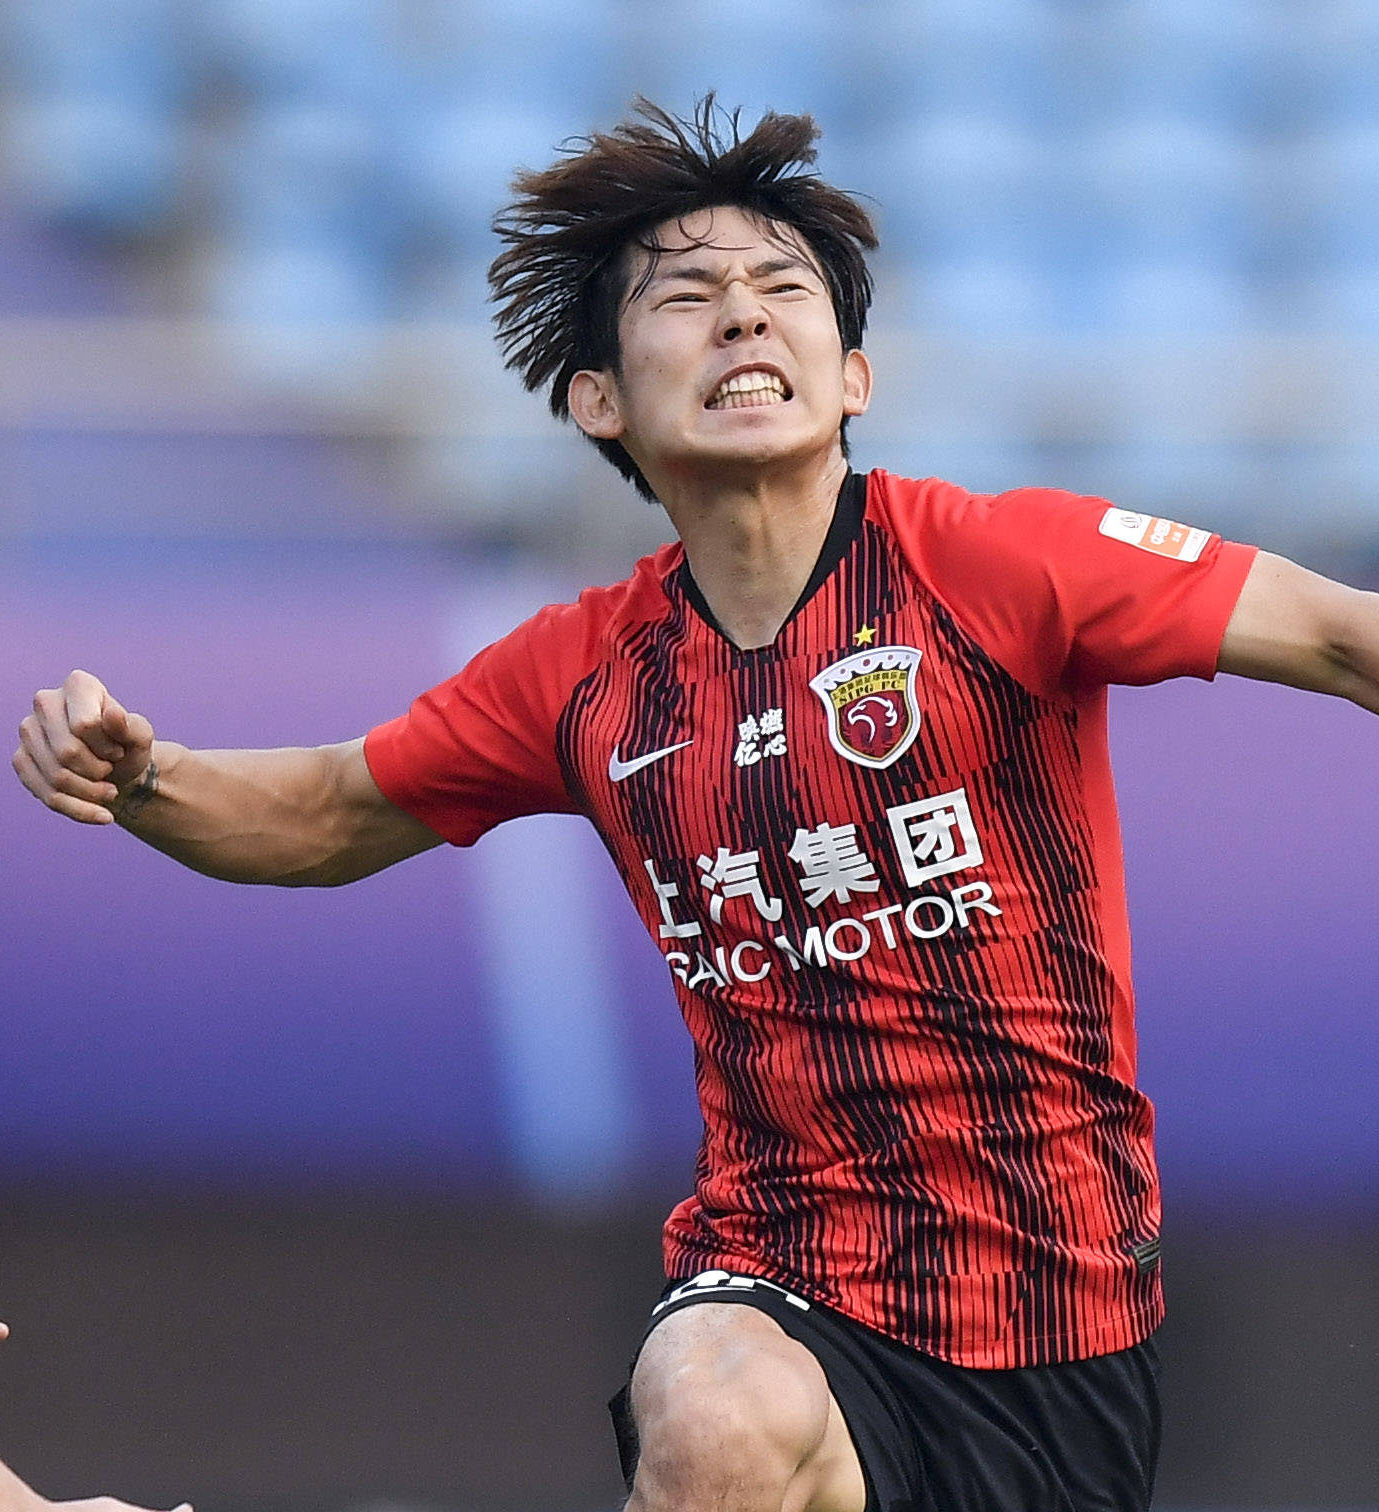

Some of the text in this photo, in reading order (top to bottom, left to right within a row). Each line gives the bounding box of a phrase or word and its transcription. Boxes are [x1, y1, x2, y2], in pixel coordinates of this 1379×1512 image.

[643, 787, 984, 939] 上汽集团
[665, 880, 1003, 990] SAIC MOTOR
